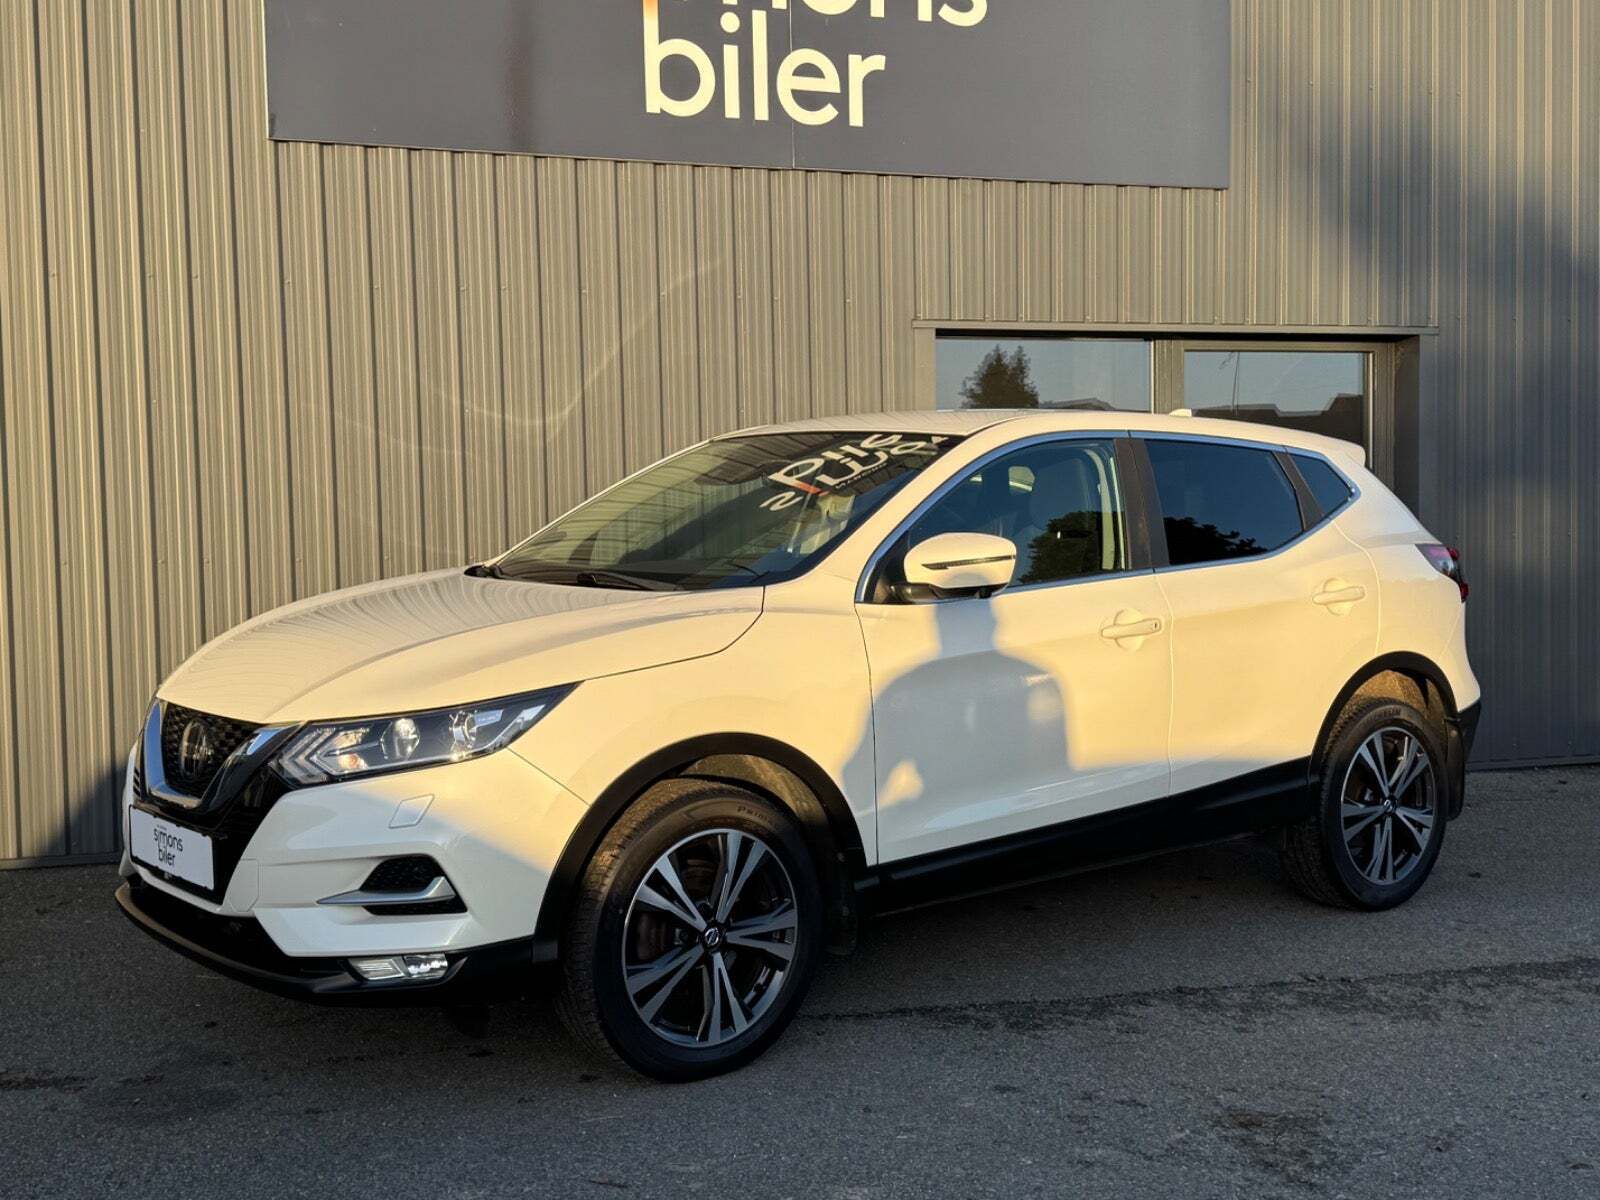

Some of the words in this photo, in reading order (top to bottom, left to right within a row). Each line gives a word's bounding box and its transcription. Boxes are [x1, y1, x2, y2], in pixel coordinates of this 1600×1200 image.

[643, 5, 886, 127] biler
[153, 827, 183, 852] simons
[158, 845, 176, 867] biler
